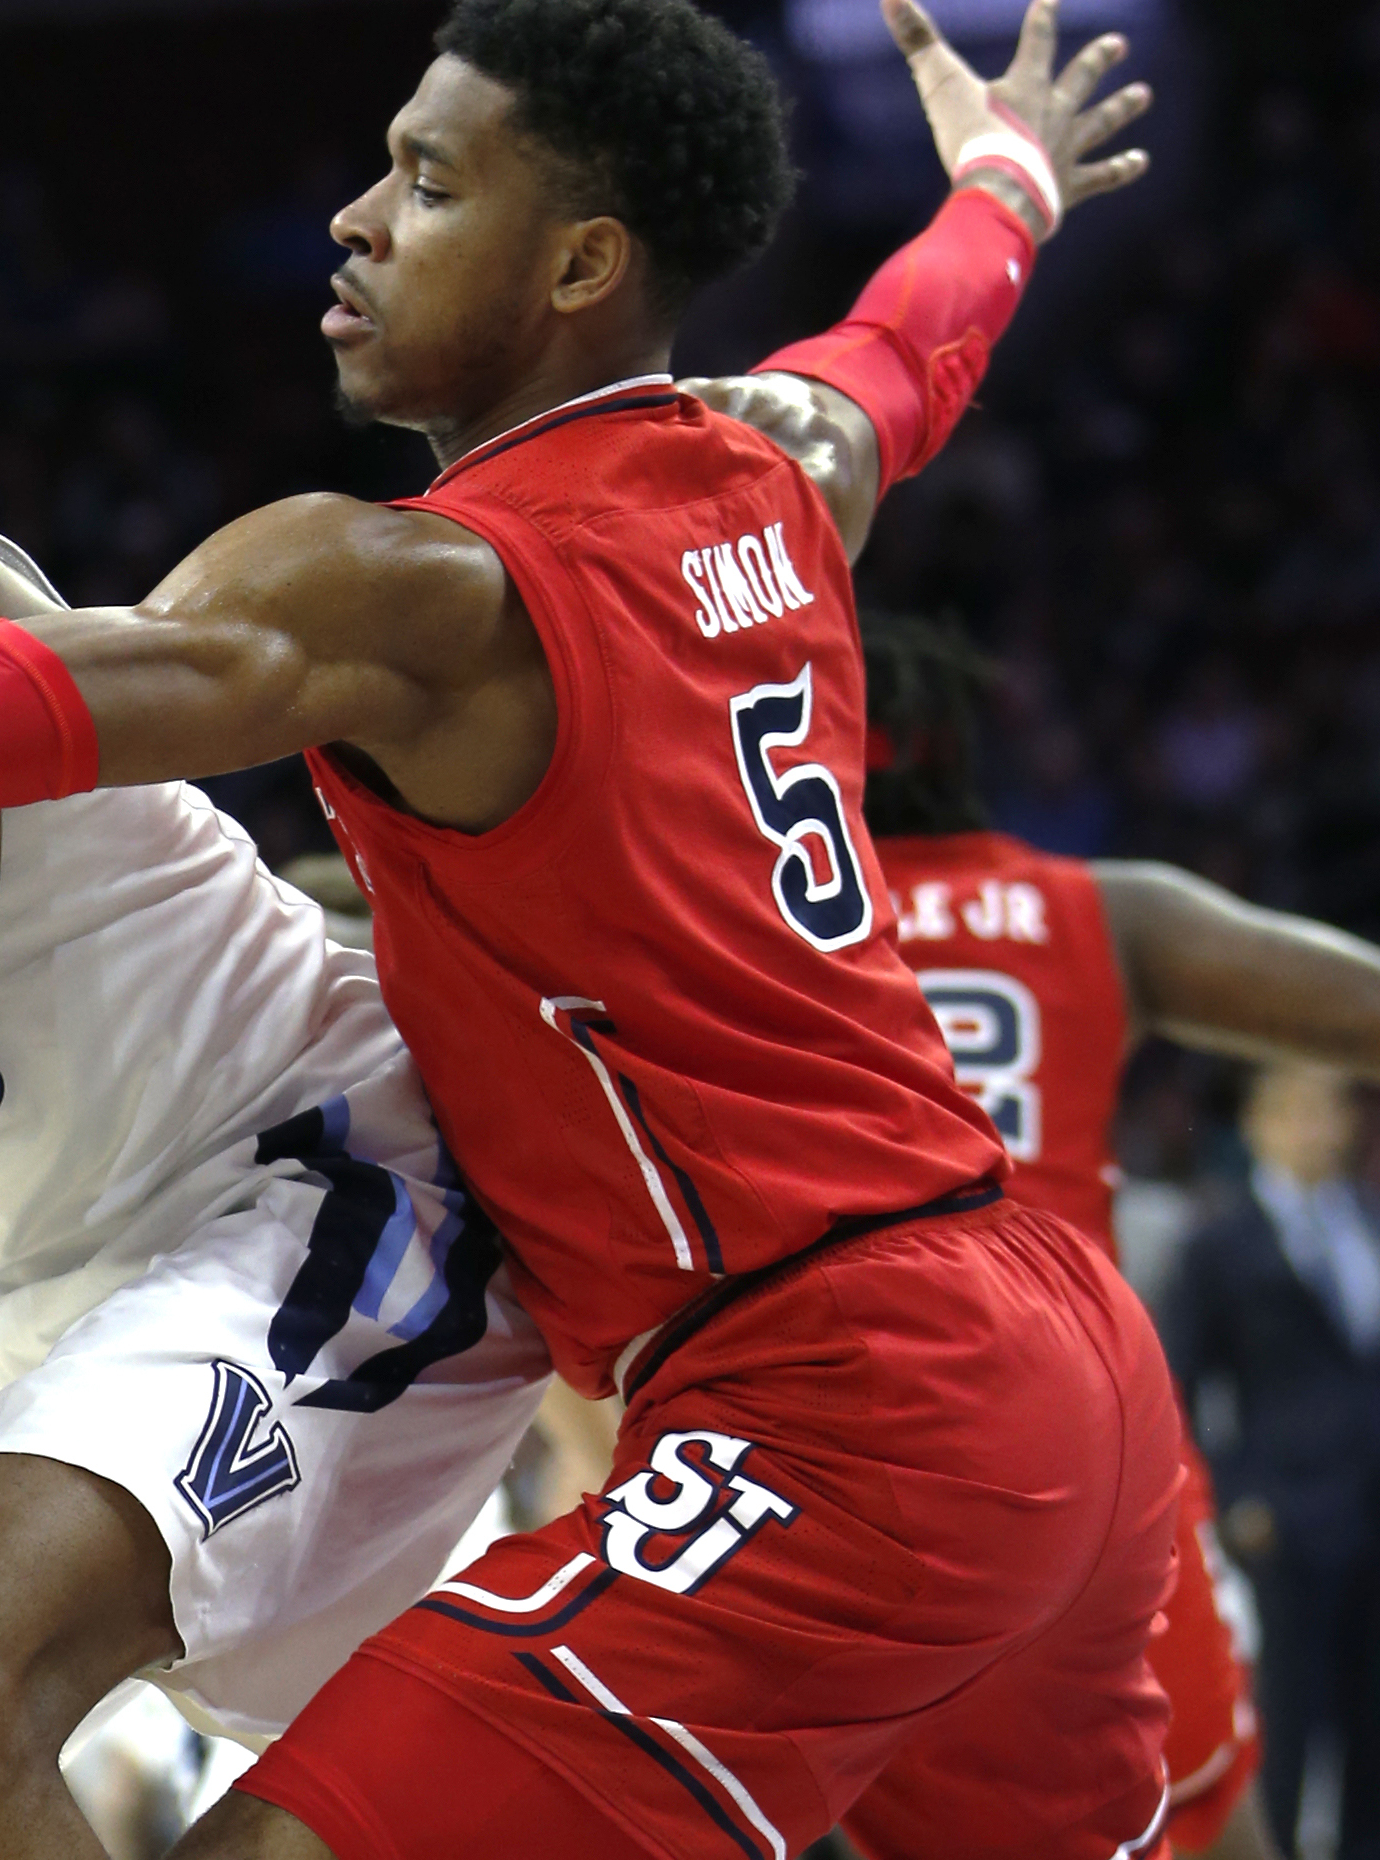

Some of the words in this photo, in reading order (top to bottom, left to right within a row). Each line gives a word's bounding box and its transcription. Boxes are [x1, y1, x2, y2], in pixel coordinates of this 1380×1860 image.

[681, 521, 815, 639] SIMON
[729, 661, 873, 953] 5
[961, 877, 1050, 946] JR
[173, 1360, 301, 1543] V
